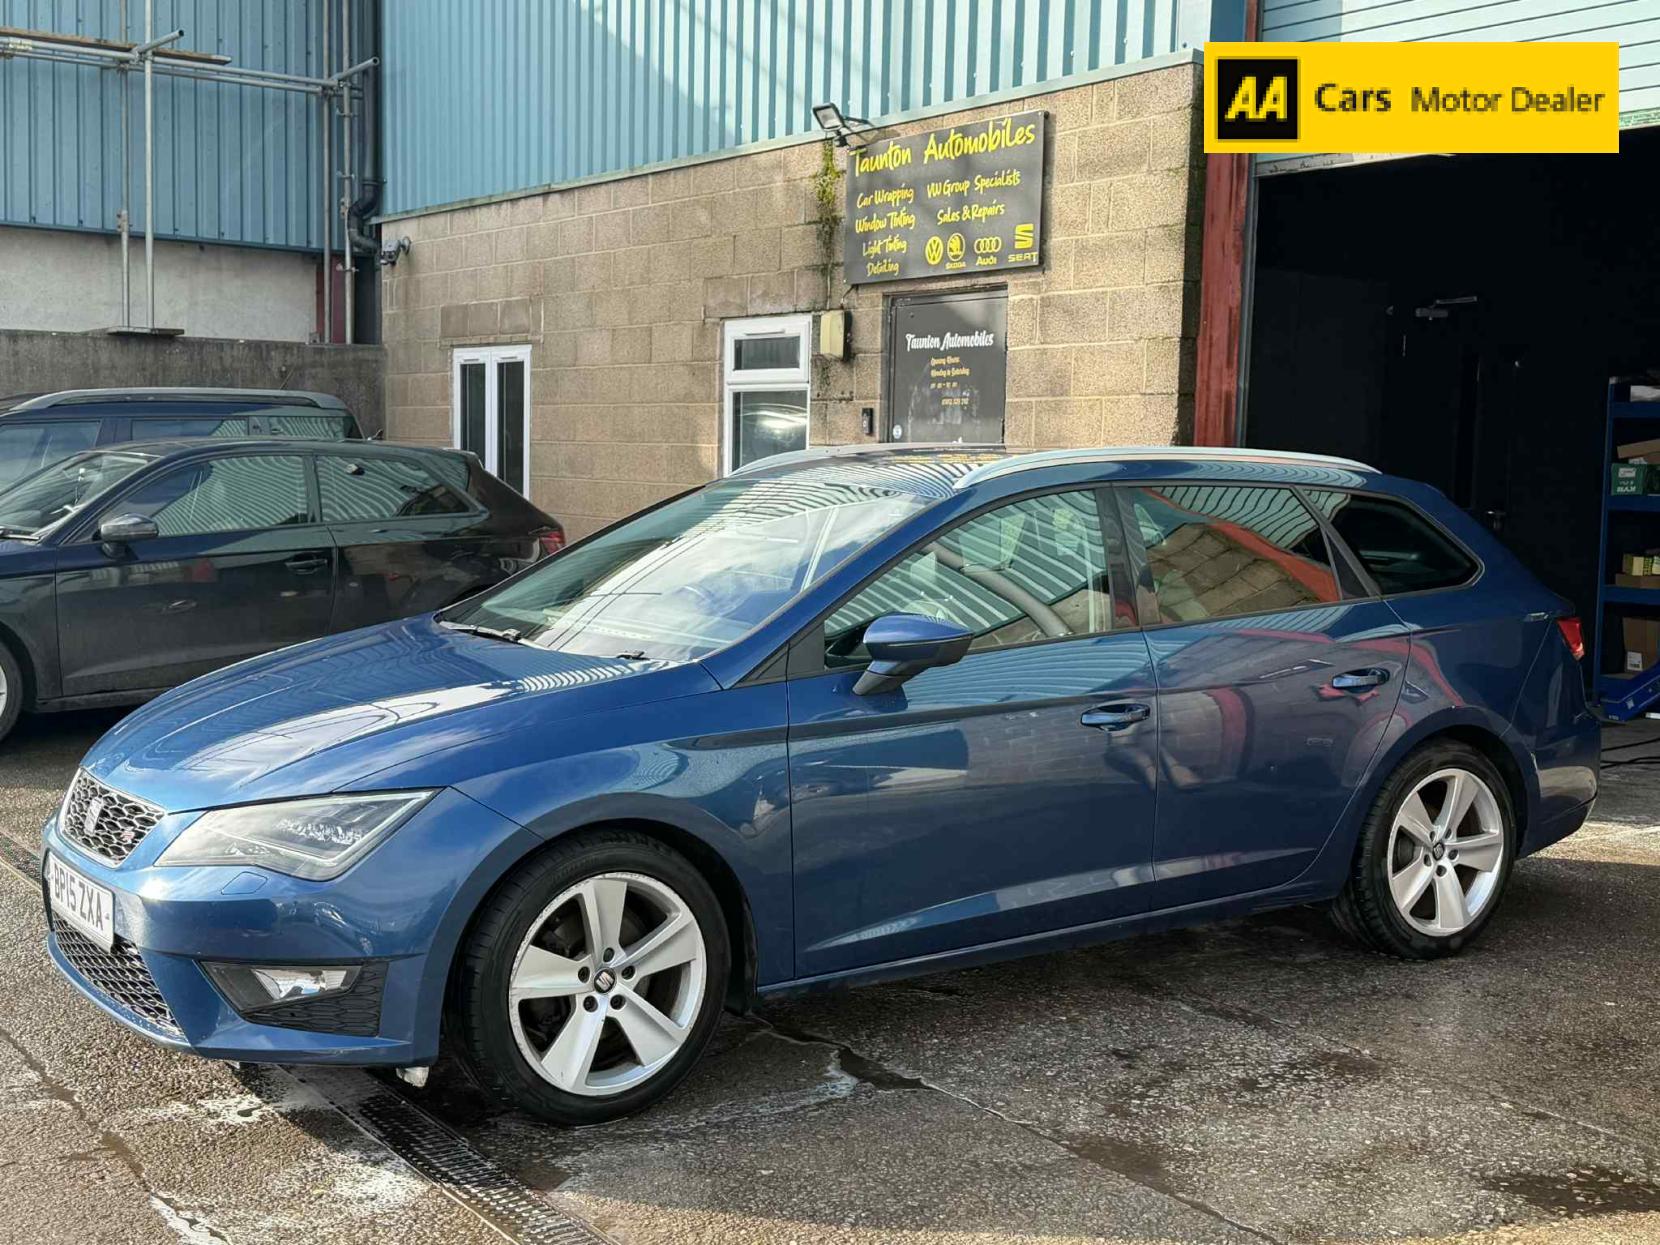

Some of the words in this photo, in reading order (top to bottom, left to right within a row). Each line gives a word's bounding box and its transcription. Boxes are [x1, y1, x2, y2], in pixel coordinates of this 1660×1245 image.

[849, 141, 912, 177] Taunton
[923, 118, 1036, 164] Automobiles
[856, 192, 873, 209] Car
[874, 183, 915, 207] Wrapping
[926, 184, 942, 199] VW
[942, 179, 971, 197] Group
[974, 168, 1021, 194] Specialists
[855, 212, 887, 234] Window
[886, 206, 916, 230] Tinting
[936, 207, 960, 226] Sales
[961, 204, 971, 221] &
[971, 199, 1006, 223] Repairs
[862, 239, 882, 259] Light
[882, 234, 907, 254] Tinting
[1008, 251, 1038, 263] SEAT
[866, 258, 900, 277] Detailing
[975, 255, 997, 266] Audi
[905, 333, 940, 352] Taunton
[940, 330, 994, 352] Automobiles
[78, 880, 104, 931] ZXA
